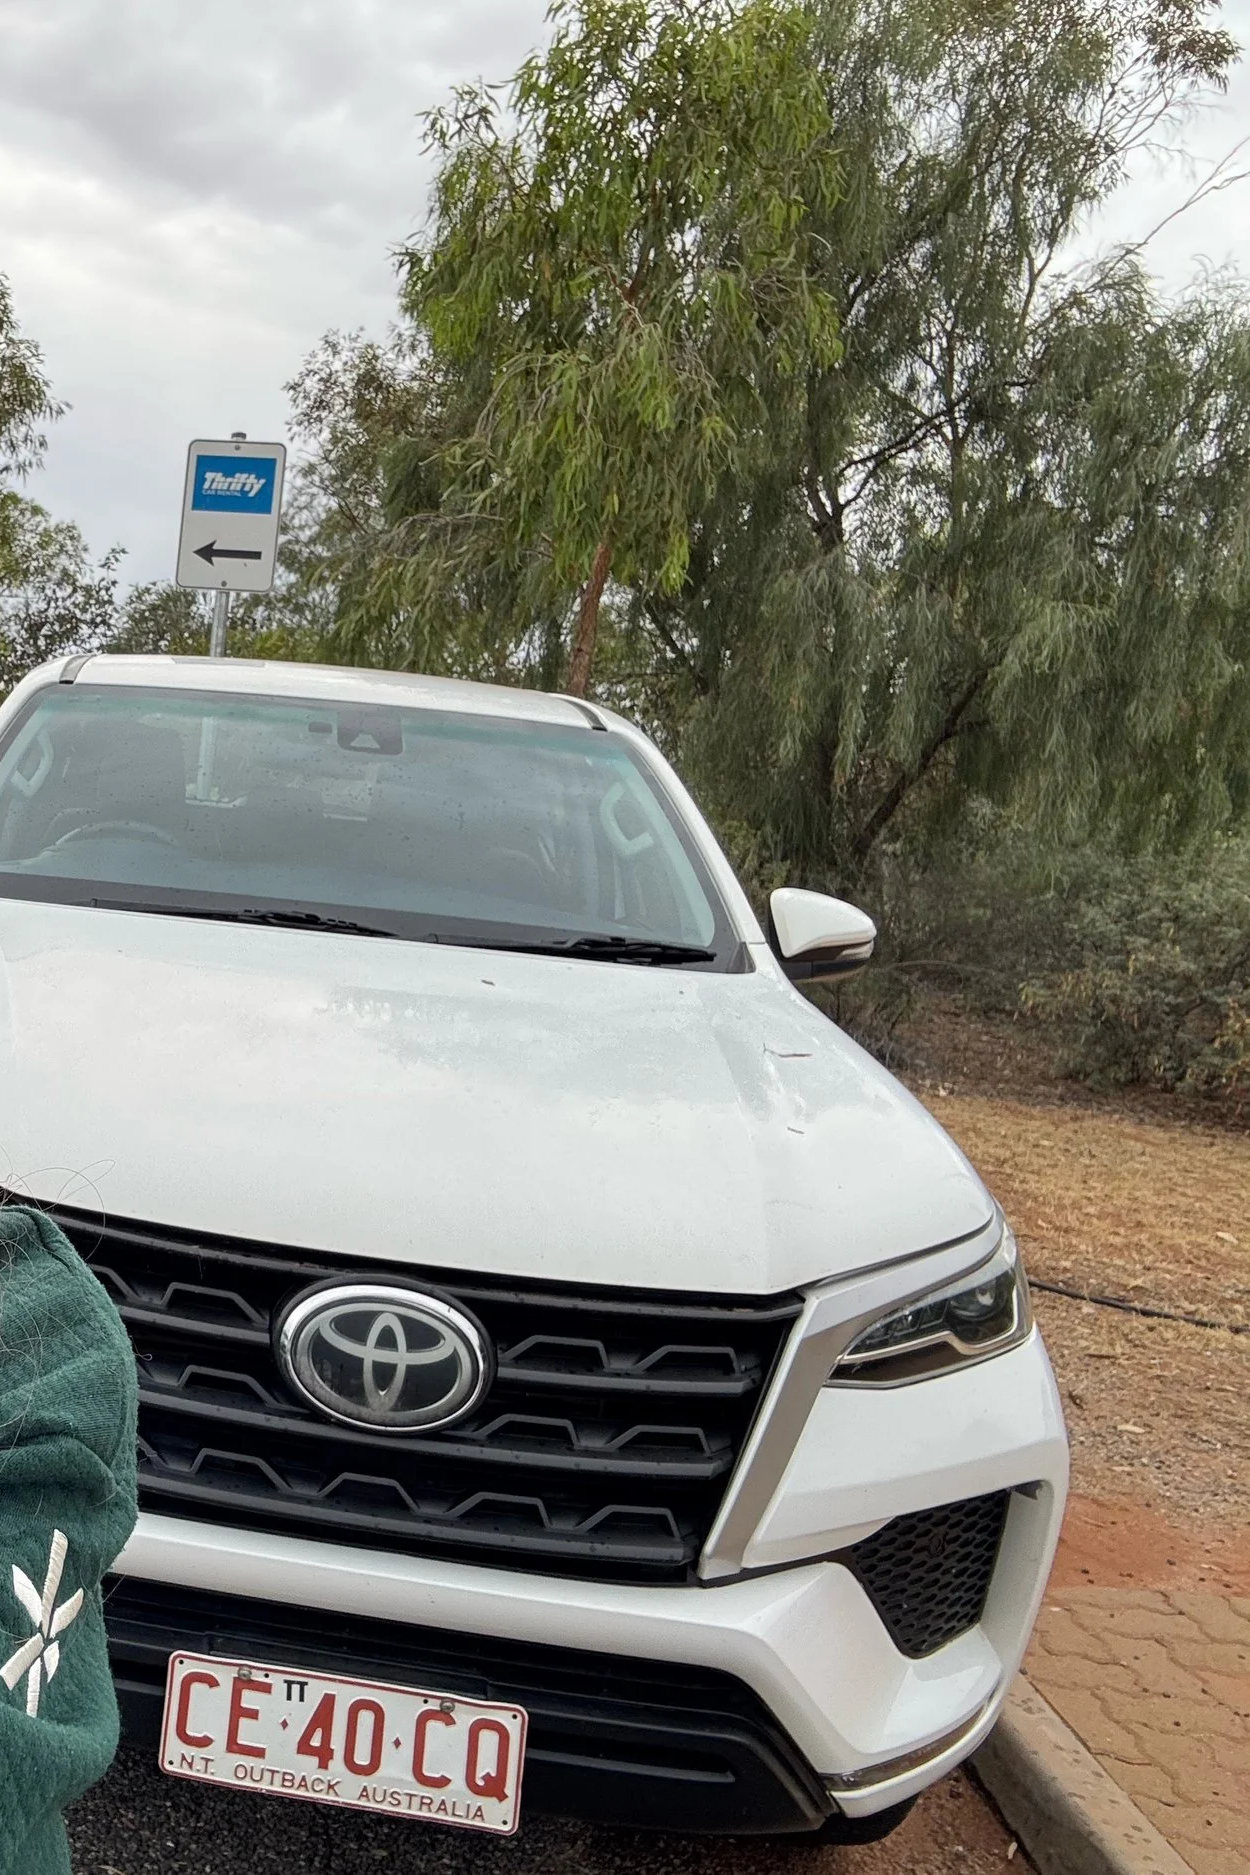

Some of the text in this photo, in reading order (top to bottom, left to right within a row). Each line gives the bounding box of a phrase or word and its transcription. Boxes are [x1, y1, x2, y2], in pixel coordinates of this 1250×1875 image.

[202, 472, 266, 497] Thrifty
[180, 1752, 485, 1821] N.T. OUTBACK AUSTRALIA
